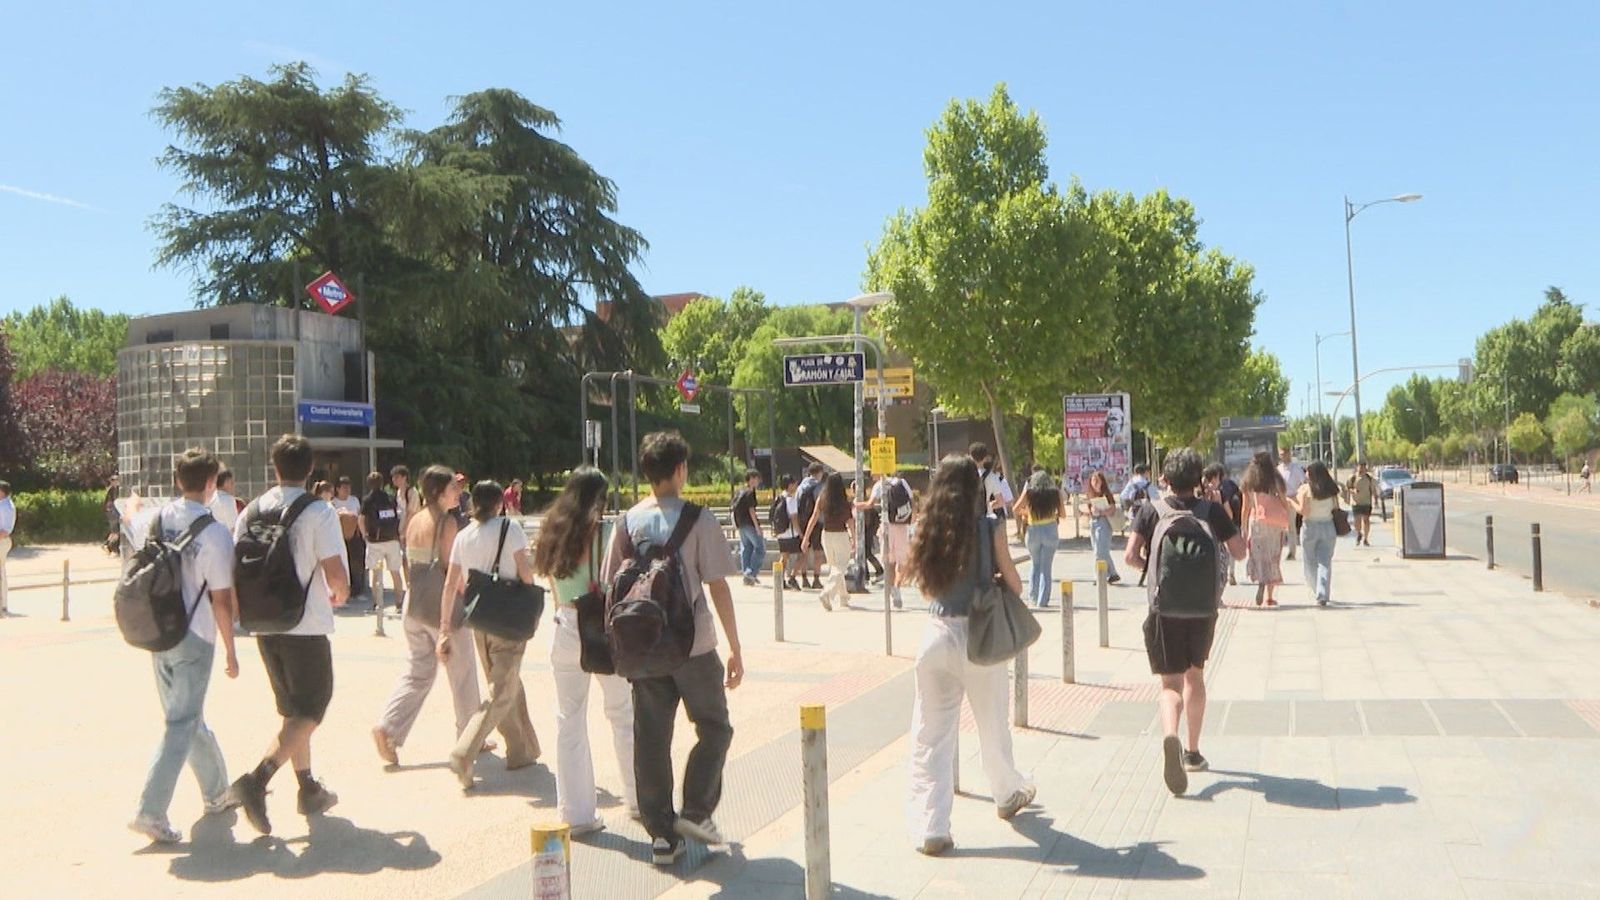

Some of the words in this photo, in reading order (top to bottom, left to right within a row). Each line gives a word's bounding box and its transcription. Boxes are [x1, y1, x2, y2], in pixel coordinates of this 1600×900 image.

[323, 286, 344, 299] Metro
[828, 368, 835, 379] Y
[311, 406, 330, 415] Ciudad
[331, 407, 363, 417] Universitaria
